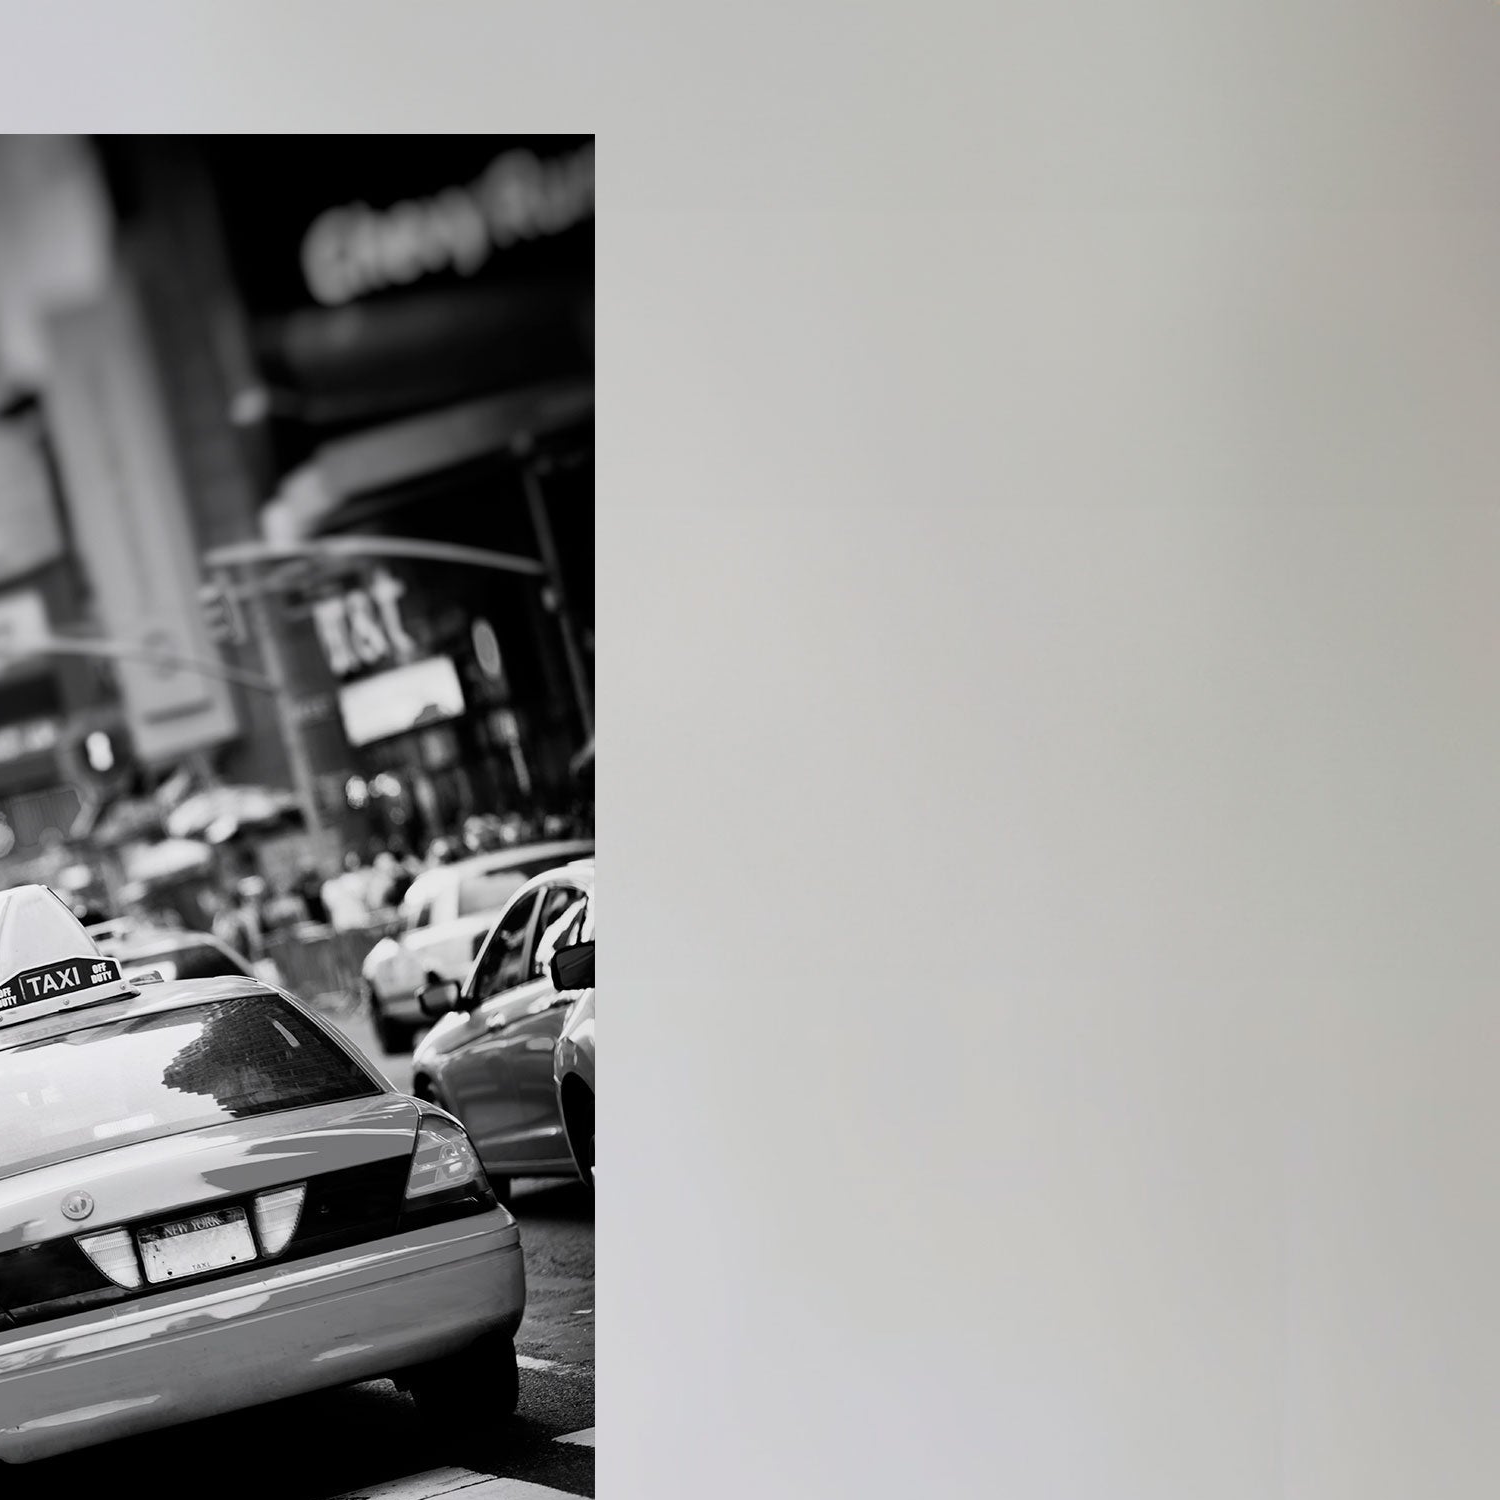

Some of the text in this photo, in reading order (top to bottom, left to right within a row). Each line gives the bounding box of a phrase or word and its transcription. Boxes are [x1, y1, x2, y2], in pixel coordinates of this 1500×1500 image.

[91, 962, 107, 975] OFF
[26, 966, 81, 997] TAXI
[90, 970, 112, 984] DUTY
[163, 1215, 220, 1238] NEW YORK
[192, 1262, 211, 1270] TAXI
